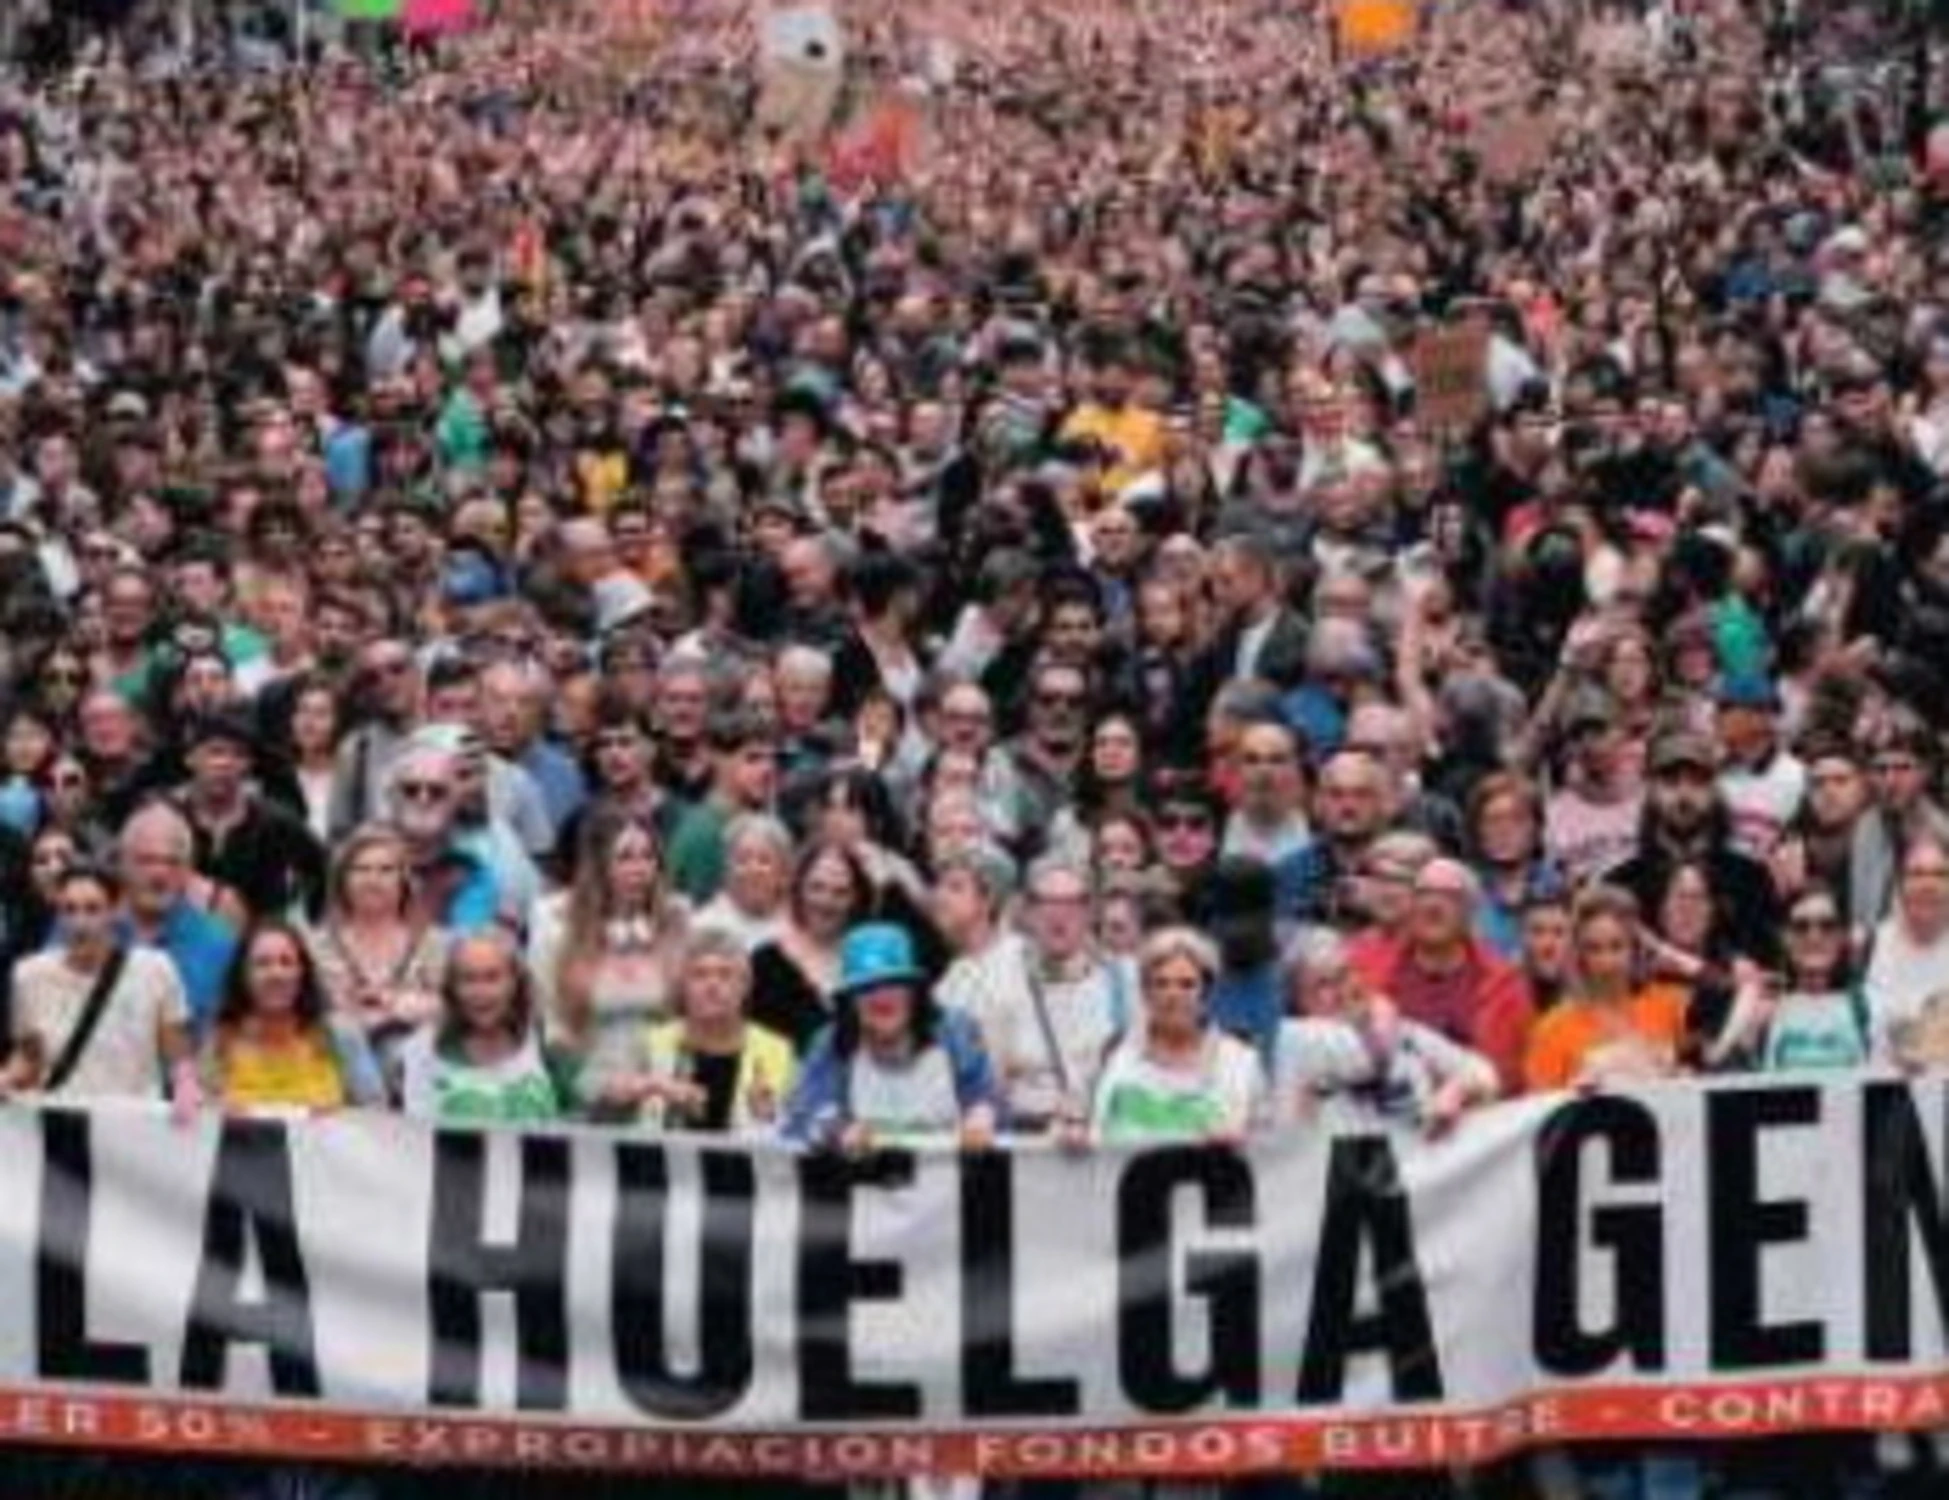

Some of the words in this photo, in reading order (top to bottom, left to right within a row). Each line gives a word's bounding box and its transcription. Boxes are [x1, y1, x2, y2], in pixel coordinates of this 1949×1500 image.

[35, 1108, 323, 1398] LA
[427, 1130, 1446, 1422] HUELGA
[1532, 1082, 1949, 1377] GEN
[0, 1395, 99, 1437] ER
[975, 1425, 1286, 1473] FONDOS
[1659, 1381, 1947, 1429] CONTRA
